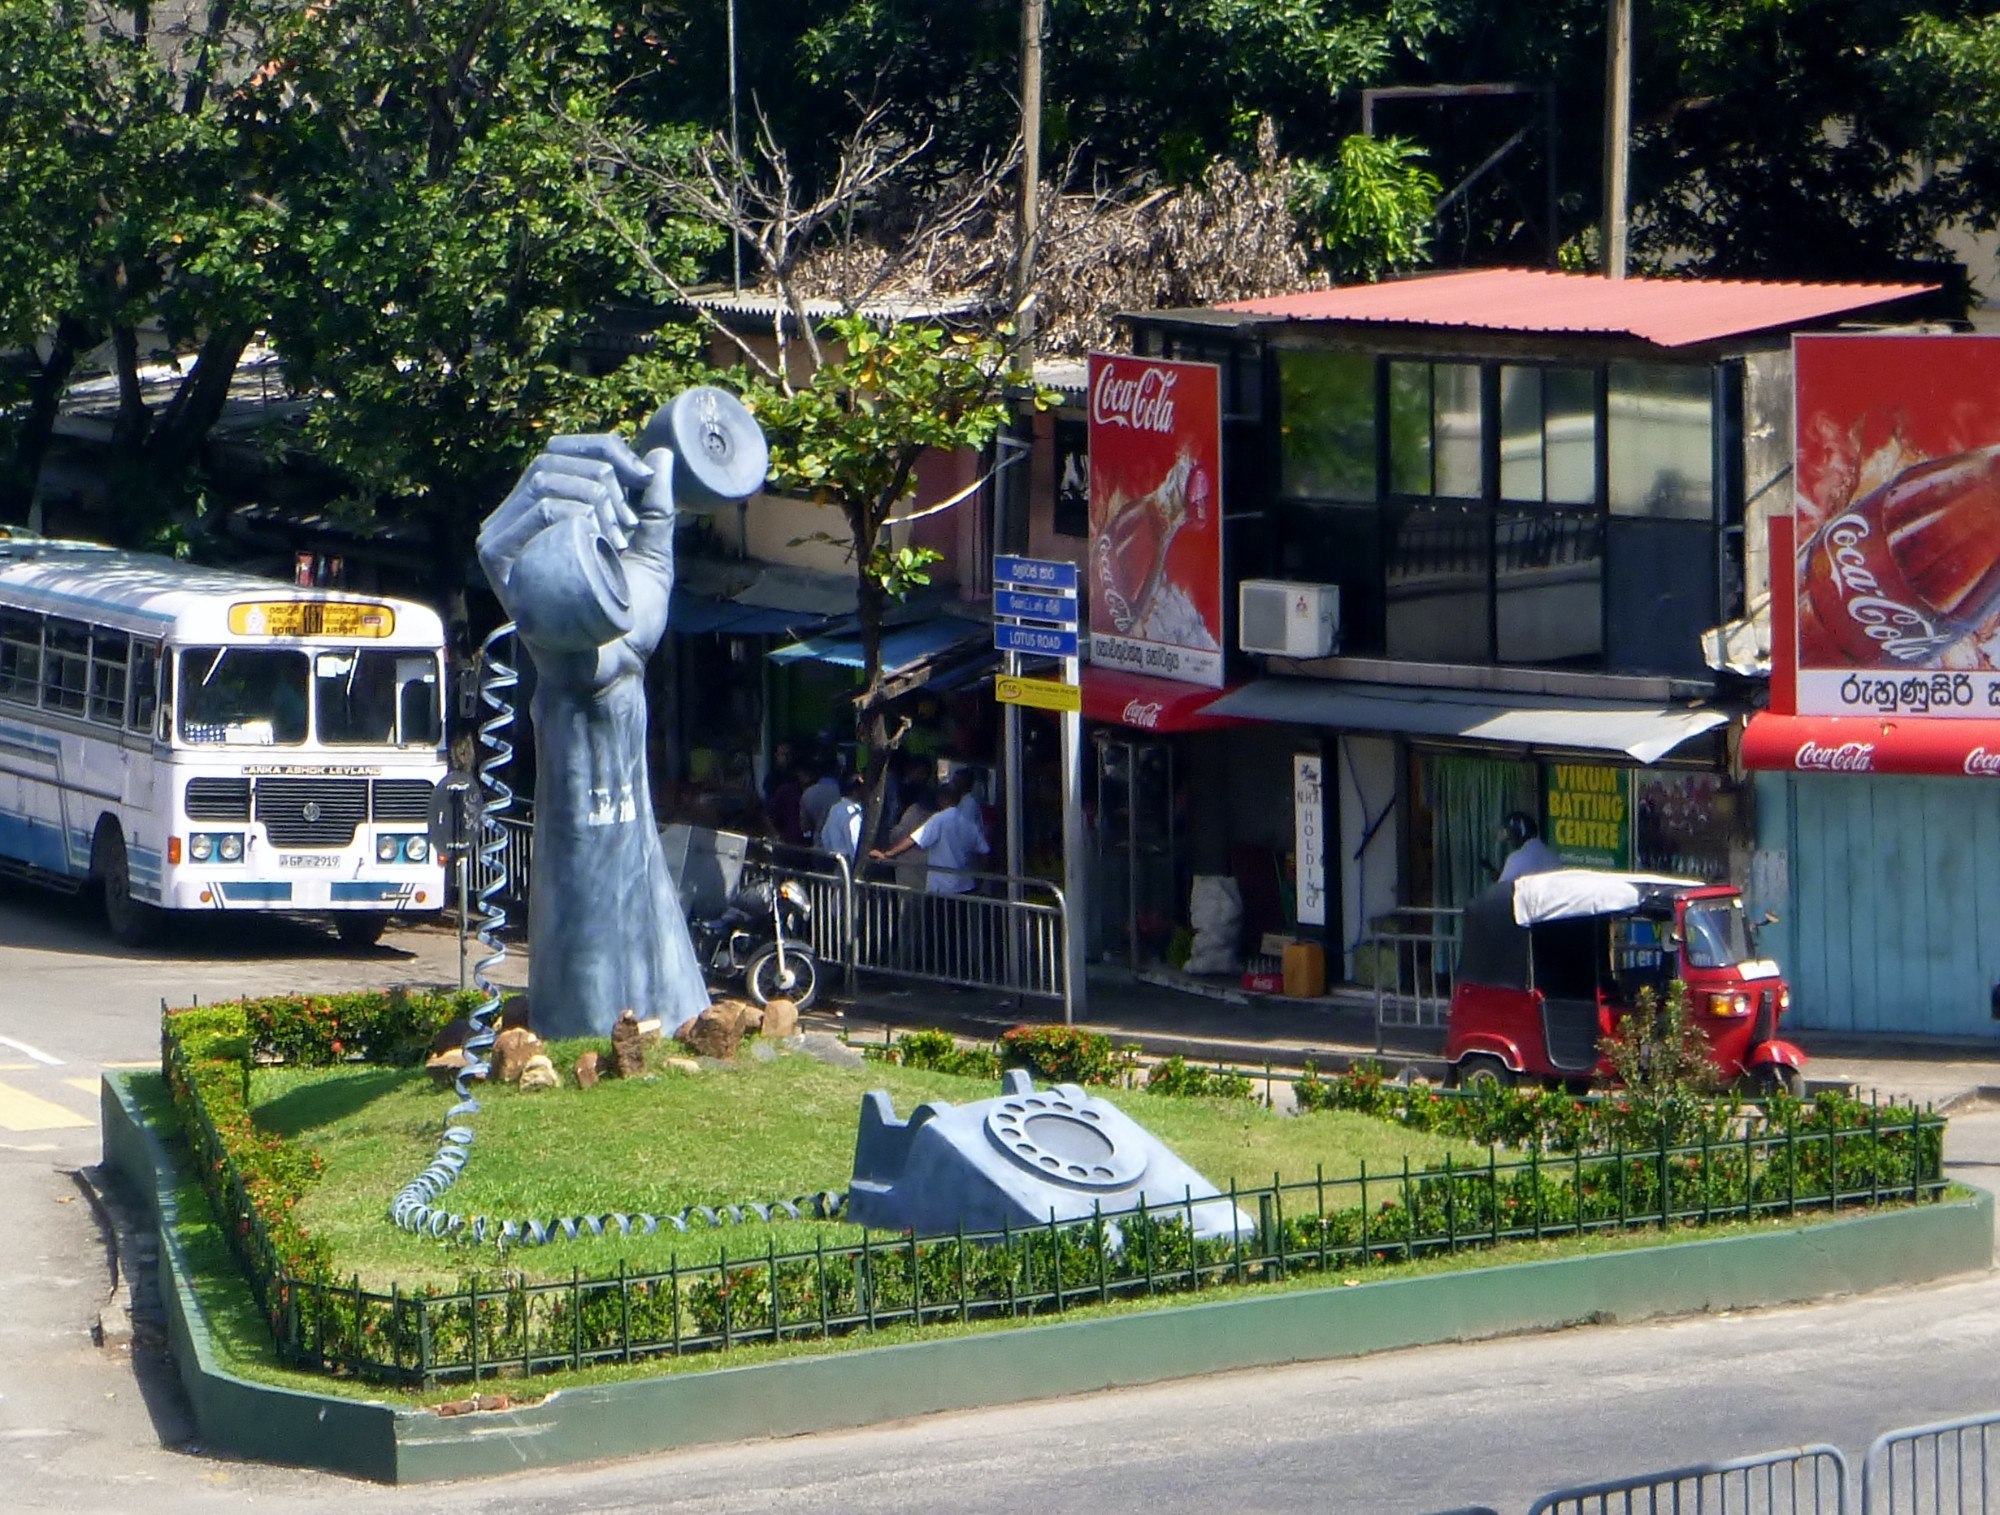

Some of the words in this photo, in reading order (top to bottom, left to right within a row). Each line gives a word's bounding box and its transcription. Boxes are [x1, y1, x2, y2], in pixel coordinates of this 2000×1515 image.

[1093, 362, 1178, 433] Coca-Cola
[1824, 513, 1952, 660] Coca-Cola
[1009, 631, 1036, 647] LOTUS
[1037, 635, 1061, 650] ROAD
[1795, 741, 1874, 770] Coca-Cola
[242, 766, 281, 774] LANKA
[285, 766, 325, 775] ASHOK
[329, 767, 382, 776] LEYLAND
[1555, 765, 1617, 791] VIKUM
[1548, 791, 1624, 820] BATTING
[1555, 819, 1619, 849] CENTRE
